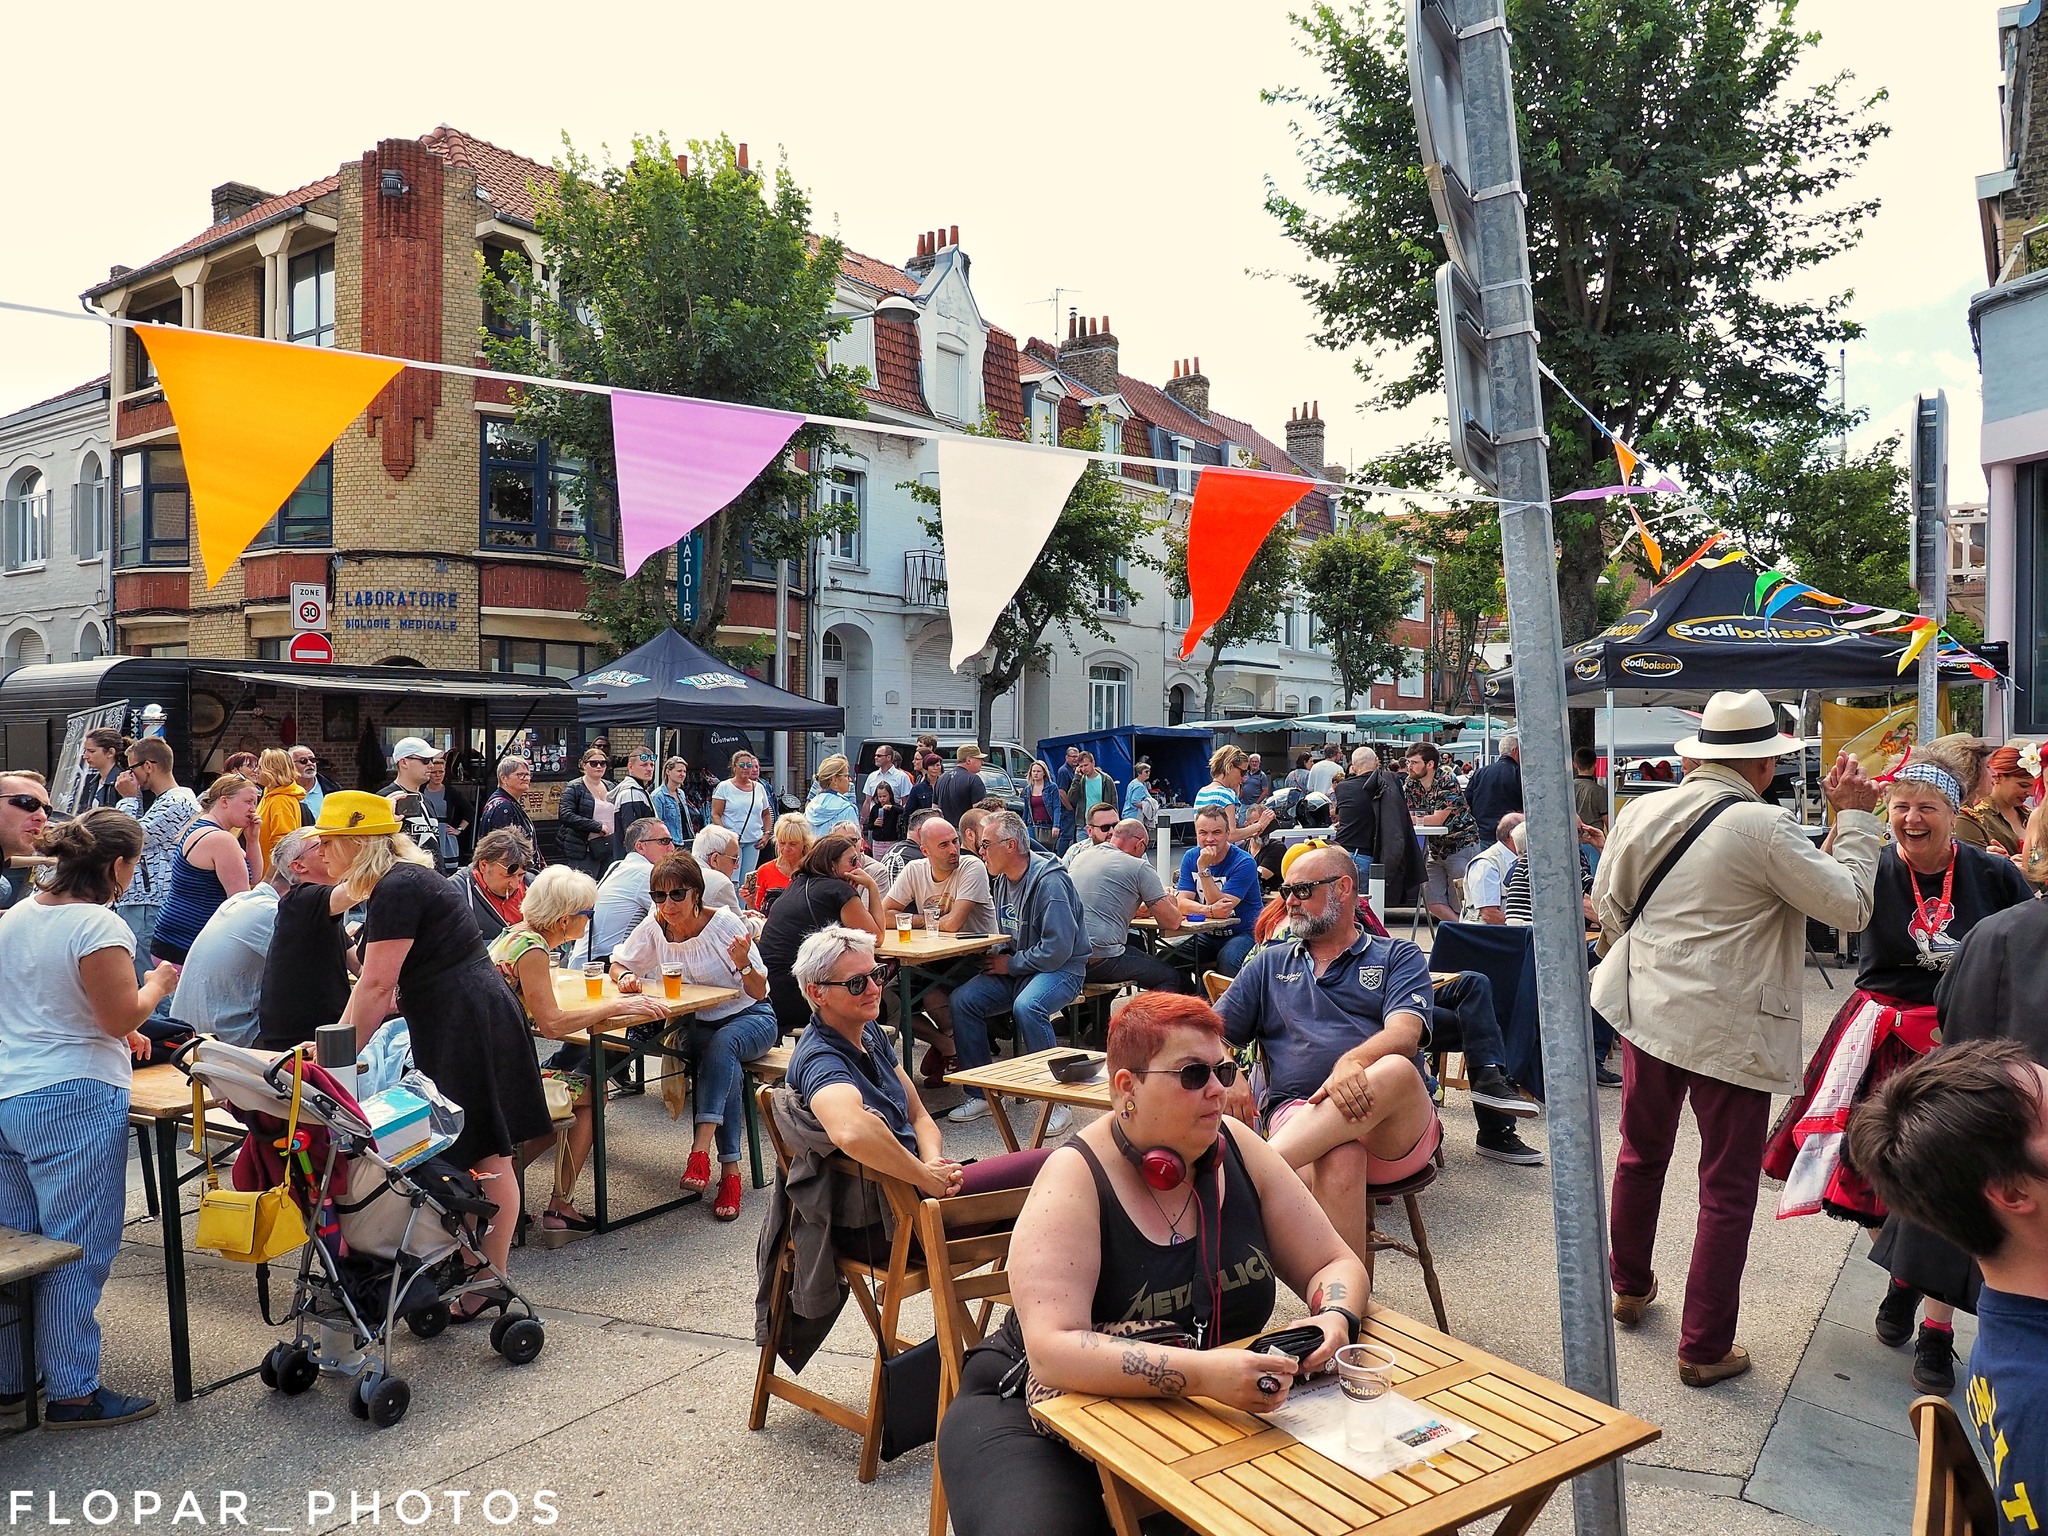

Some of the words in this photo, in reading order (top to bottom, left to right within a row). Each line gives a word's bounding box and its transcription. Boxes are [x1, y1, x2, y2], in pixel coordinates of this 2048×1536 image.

[683, 530, 692, 623] RATOIR
[345, 591, 458, 608] LABORATOIRE
[303, 607, 317, 618] 30
[345, 619, 390, 629] BIOLOGIE
[400, 619, 457, 630] MEDICALE
[1675, 624, 1850, 639] Sodiboisso
[1624, 658, 1680, 669] Sodiboissons
[1121, 1243, 1276, 1321] METLICA
